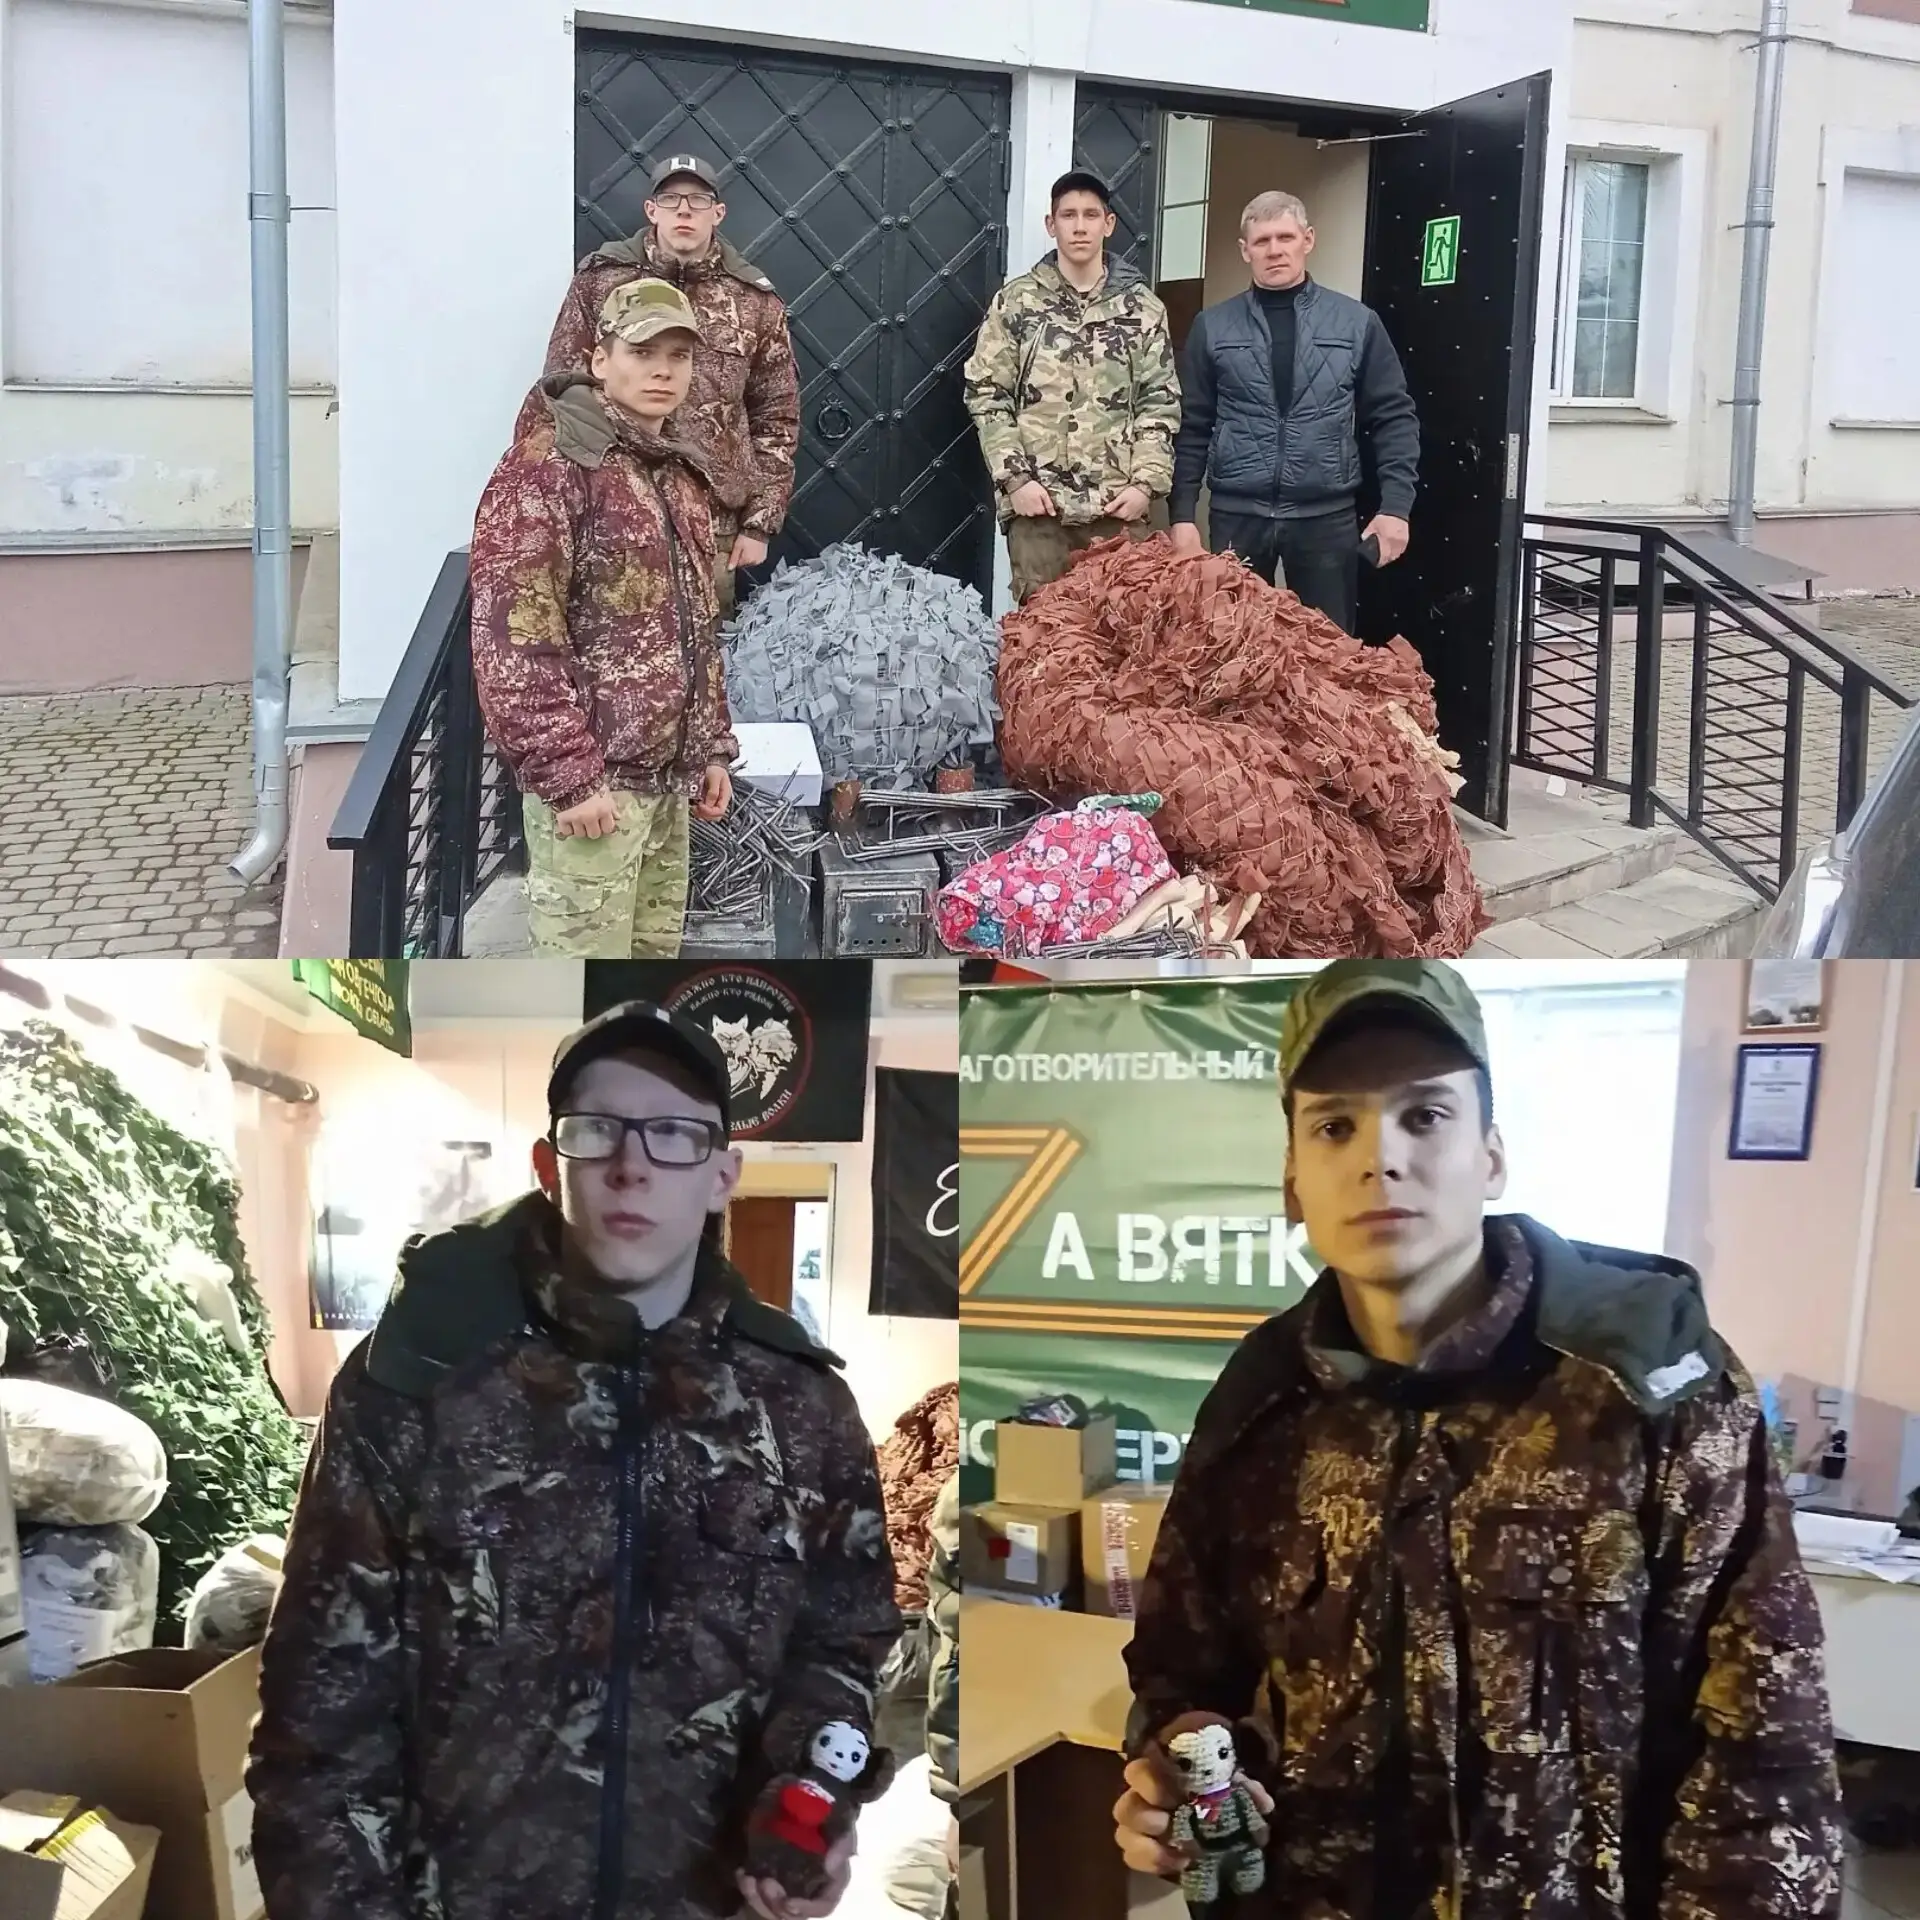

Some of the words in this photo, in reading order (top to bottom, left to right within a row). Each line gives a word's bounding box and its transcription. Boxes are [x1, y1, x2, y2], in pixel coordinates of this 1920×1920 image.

[721, 973, 744, 984] КТО
[723, 987, 742, 998] КТО
[959, 1042, 1264, 1083] АГОТВОРИТЕЛЬНЫЙ
[761, 1088, 793, 1122] ВОЛКИ
[1117, 1212, 1320, 1288] ВЯТК
